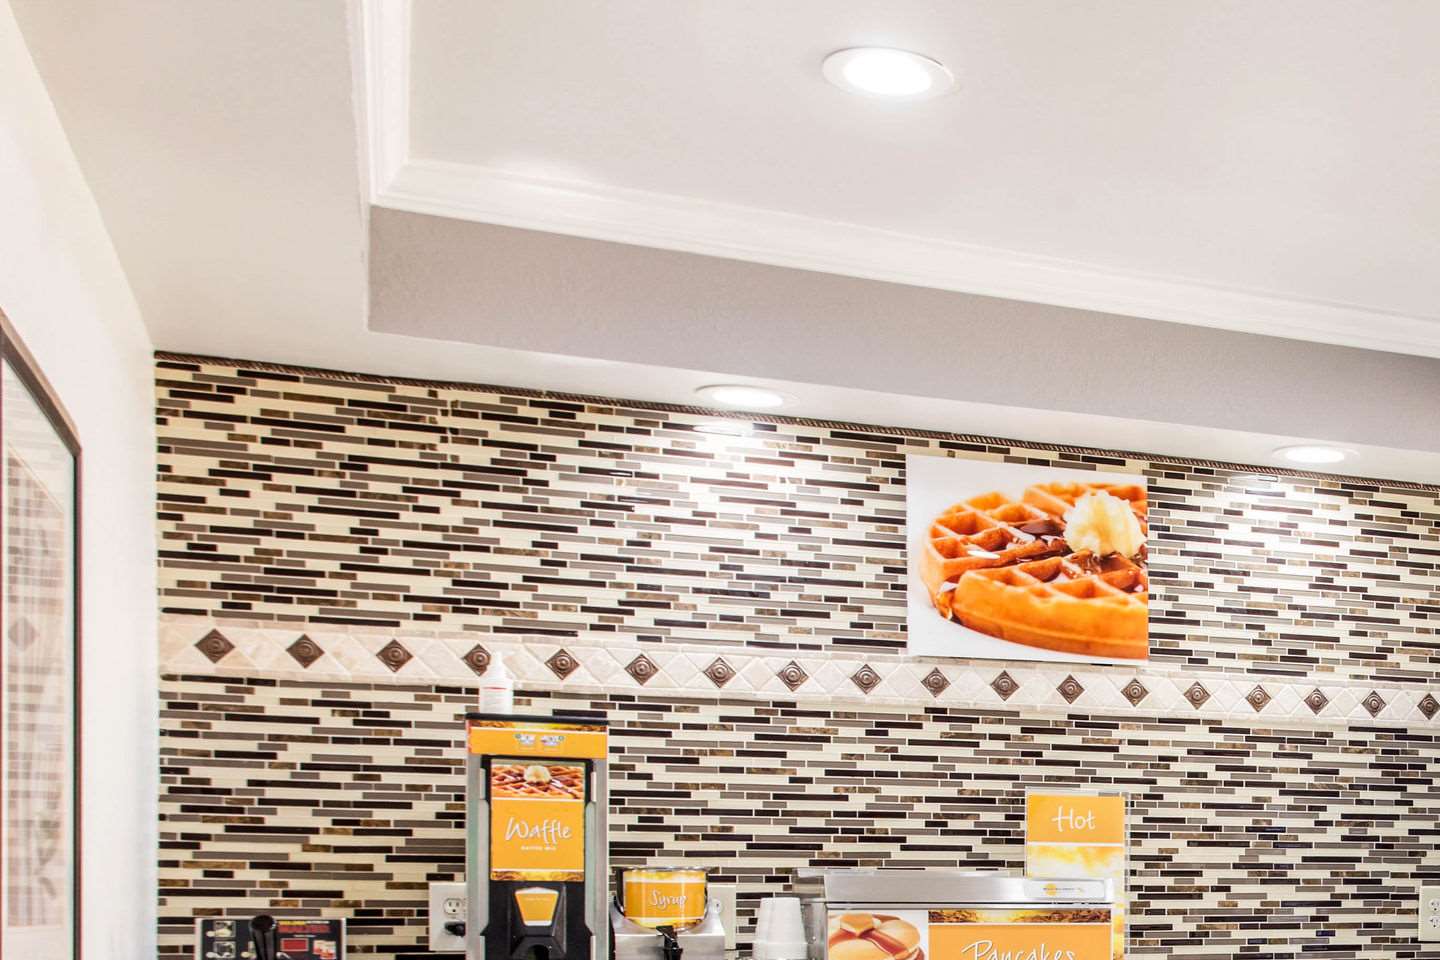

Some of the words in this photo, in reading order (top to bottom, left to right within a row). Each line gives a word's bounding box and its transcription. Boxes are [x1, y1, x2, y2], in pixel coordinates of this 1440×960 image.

[504, 816, 573, 847] Waffle
[1051, 805, 1096, 832] Hot
[651, 888, 687, 912] Syrup
